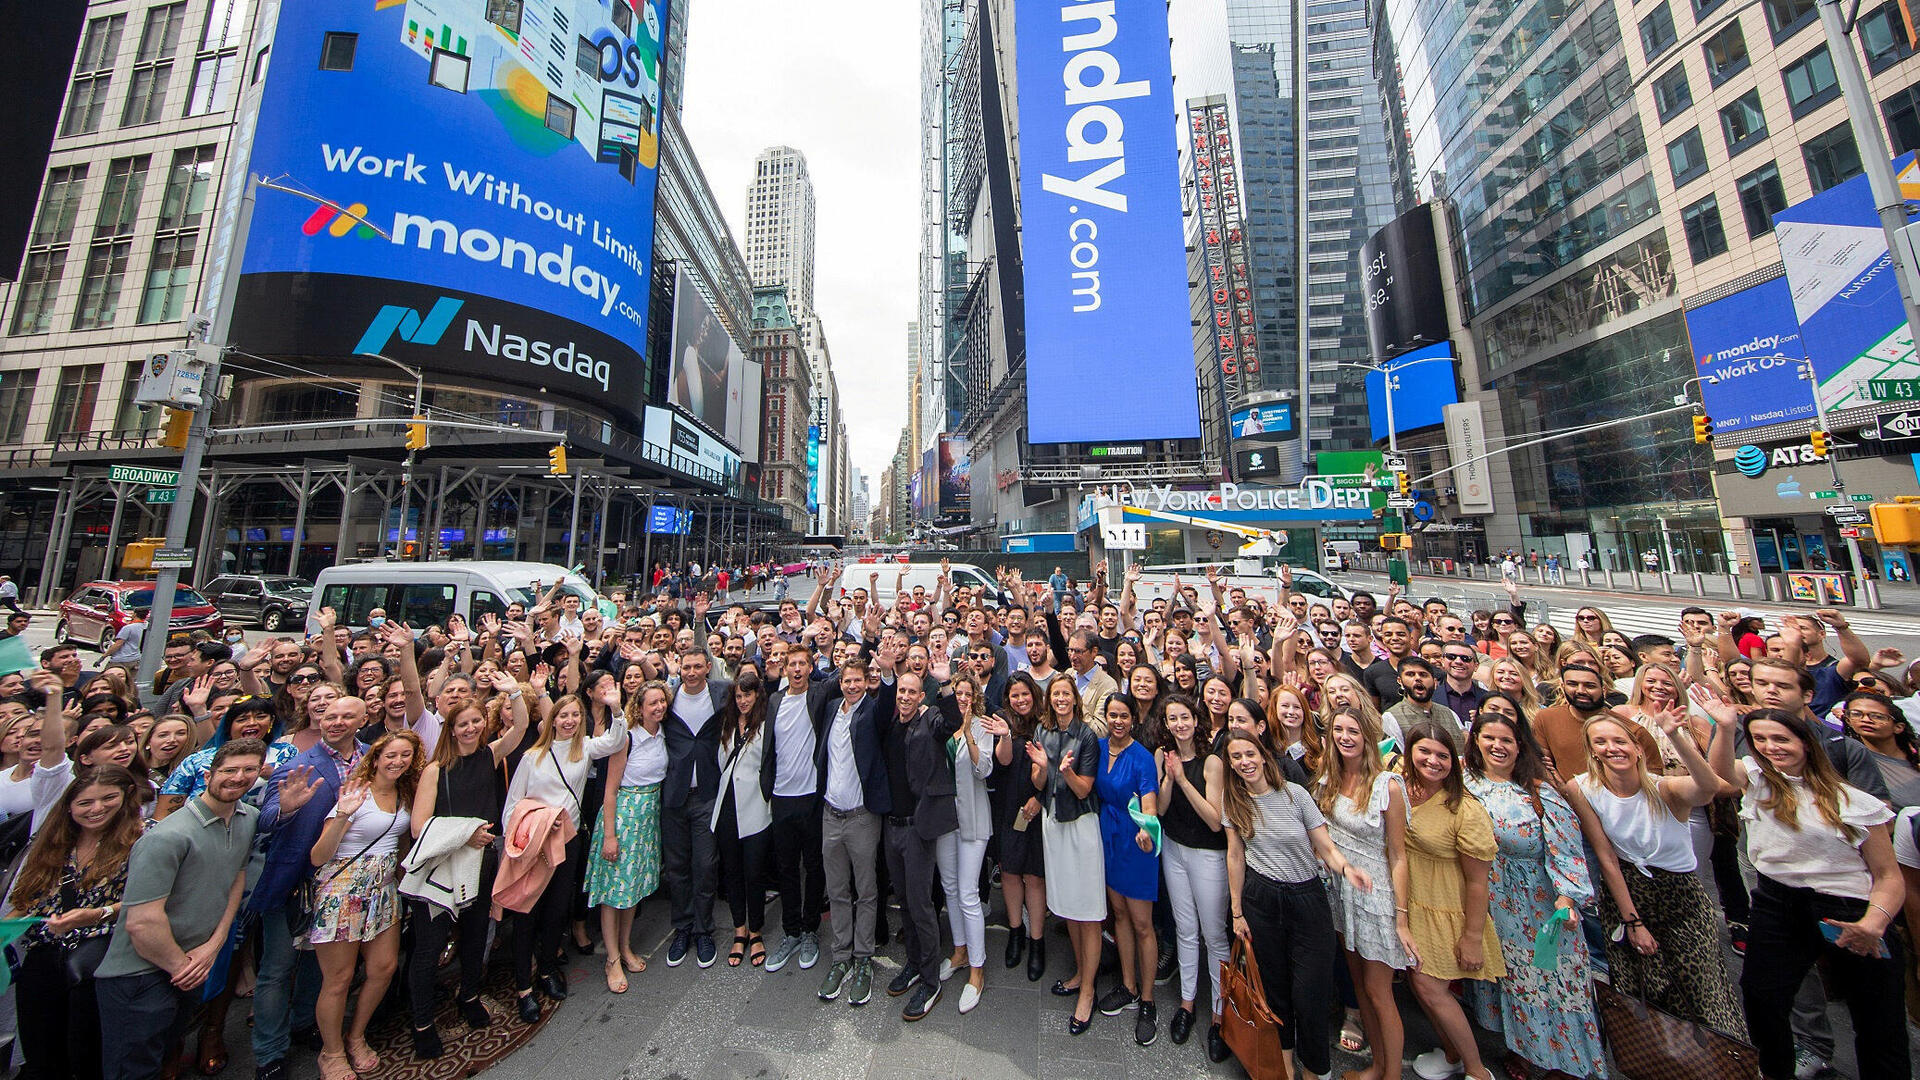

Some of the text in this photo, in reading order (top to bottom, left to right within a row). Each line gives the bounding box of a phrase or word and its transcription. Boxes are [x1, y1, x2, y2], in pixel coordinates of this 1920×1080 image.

[597, 36, 641, 89] OS
[1042, 0, 1150, 313] nday.com
[322, 143, 643, 276] Work Without Limits
[1194, 116, 1237, 375] ERNST & YOUNG
[1367, 251, 1388, 281] est
[464, 319, 611, 392] Nasdaq
[1716, 352, 1787, 381] Work OS
[1872, 382, 1887, 398] W
[1895, 381, 1913, 398] 43
[1716, 403, 1814, 429] MNDY Nasdaq Listed
[1895, 416, 1920, 430] ON
[1462, 416, 1473, 448] REUTERS
[1772, 443, 1830, 466] AT&
[112, 467, 175, 484] BROADWAY
[149, 491, 156, 502] W
[158, 490, 169, 502] 43
[1150, 484, 1213, 512] YORK
[1219, 482, 1300, 510] POLICE
[1308, 480, 1373, 510] DEPT
